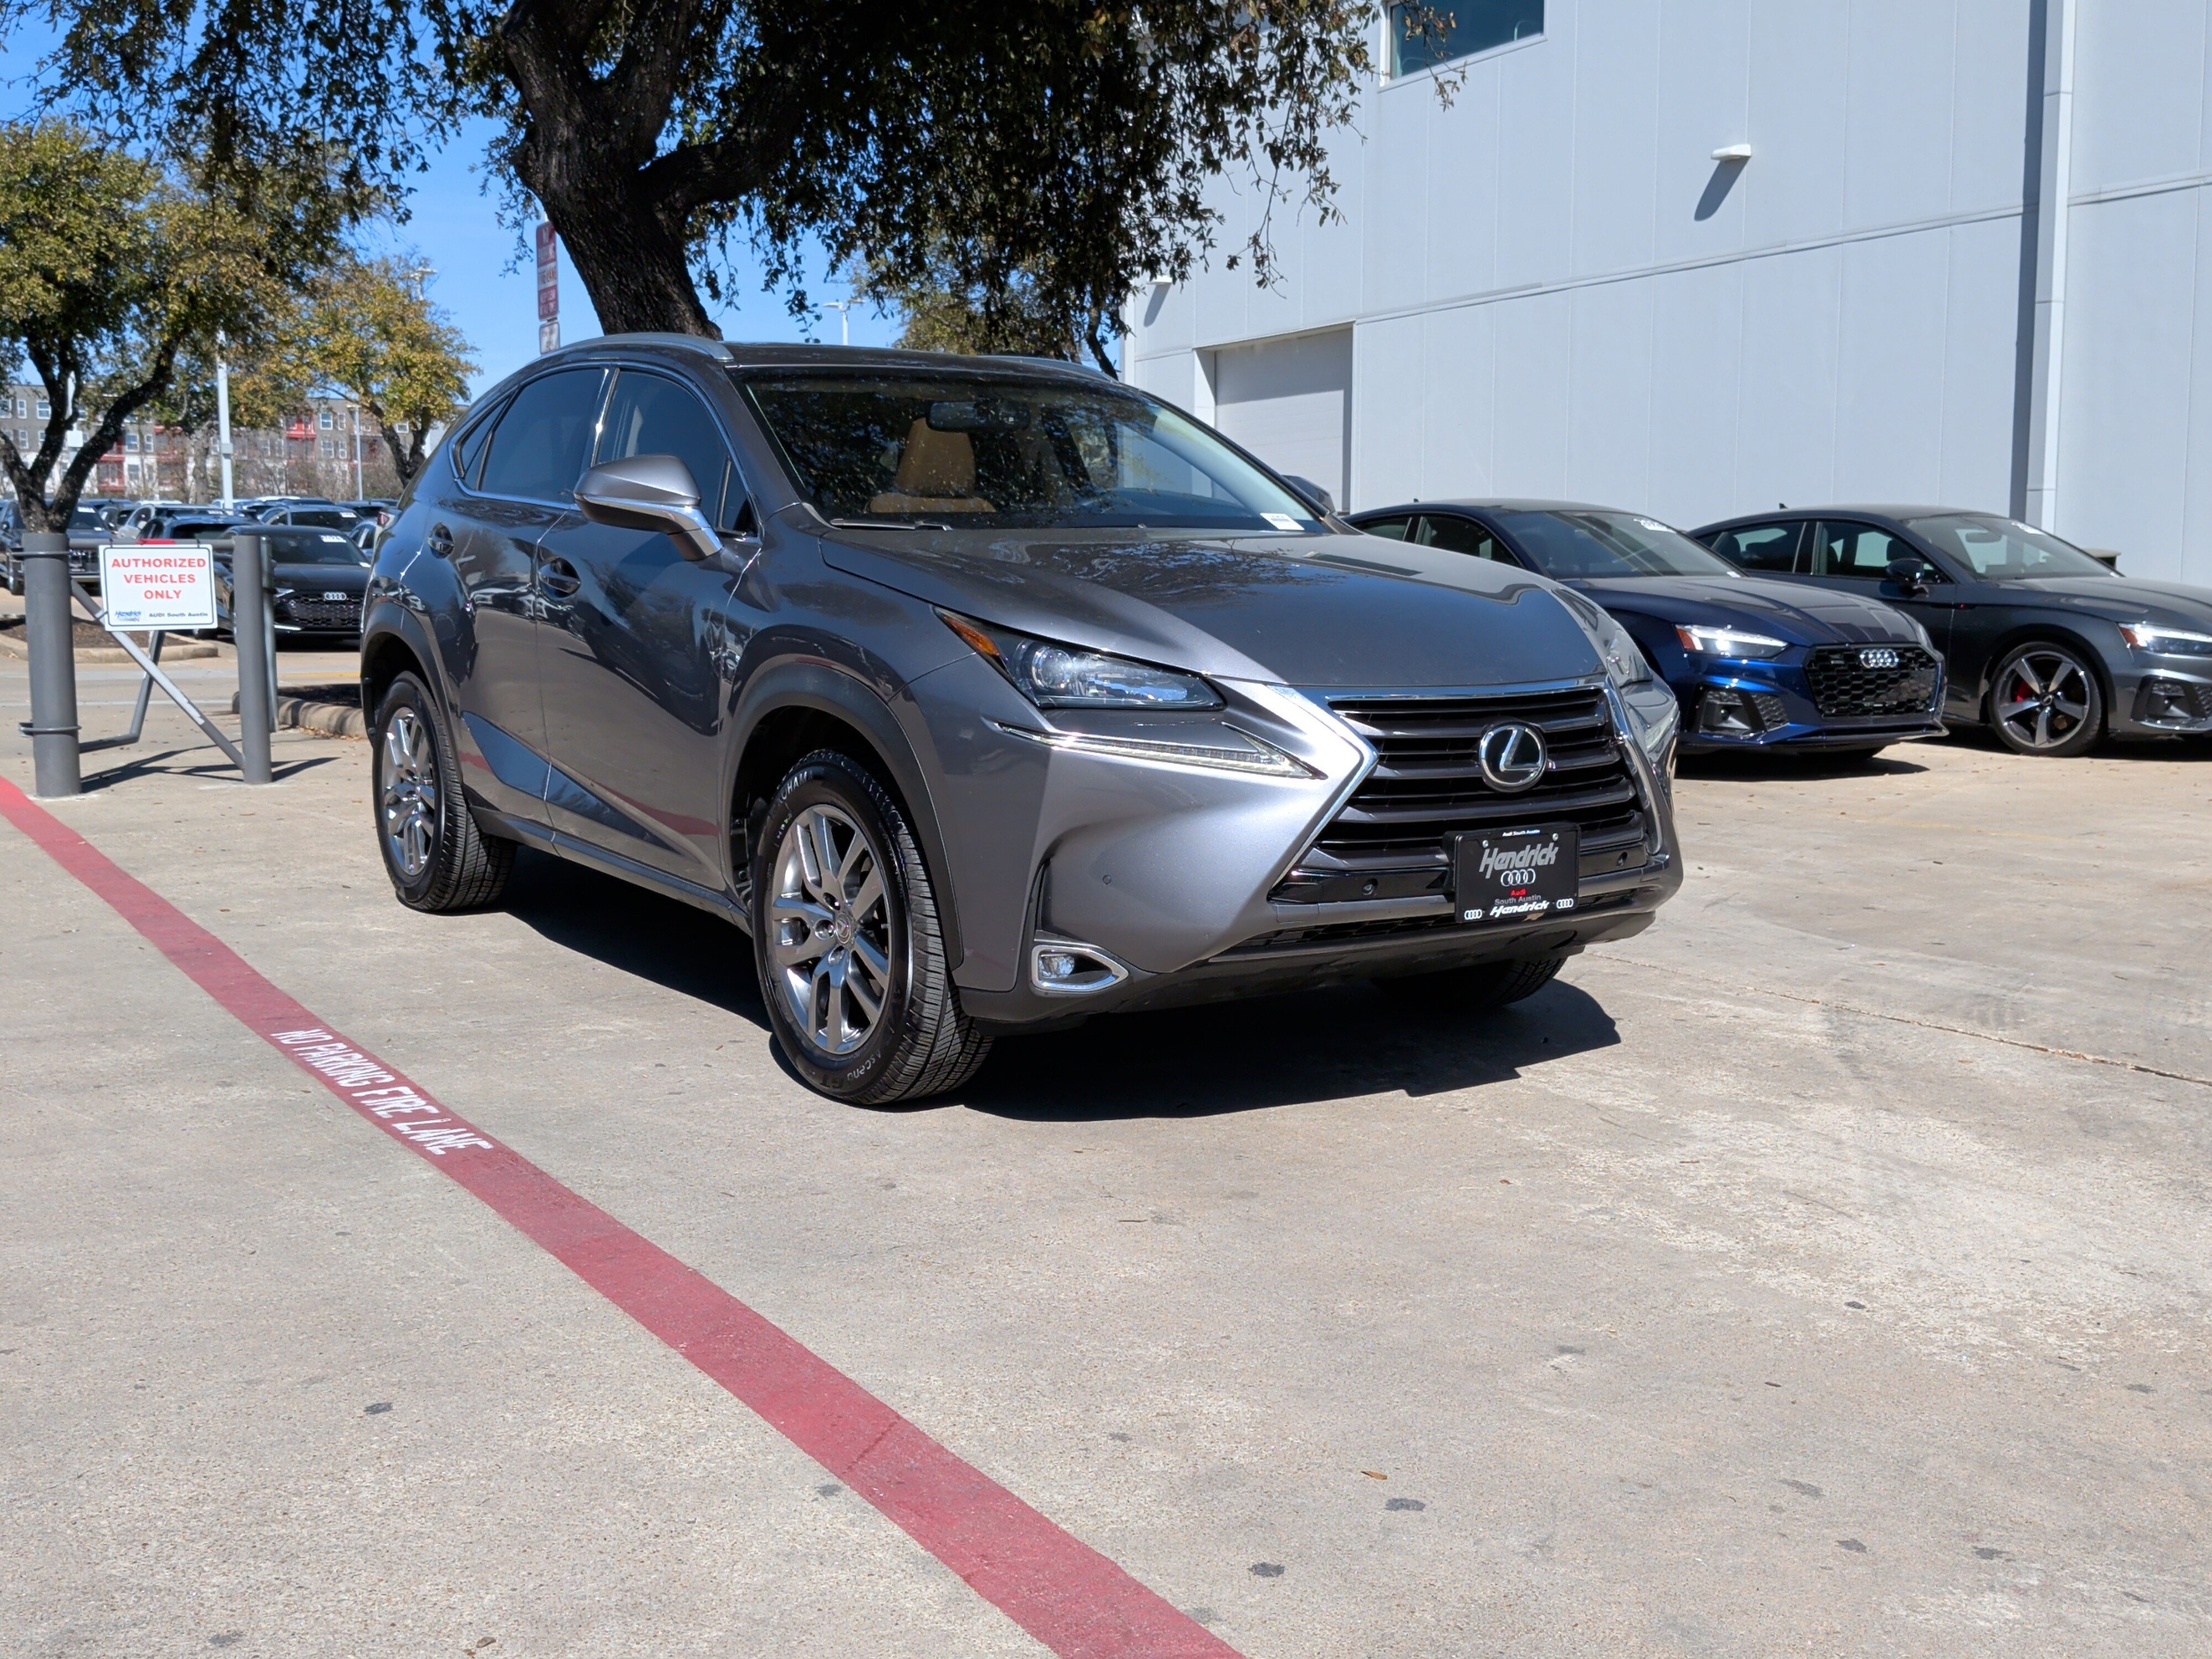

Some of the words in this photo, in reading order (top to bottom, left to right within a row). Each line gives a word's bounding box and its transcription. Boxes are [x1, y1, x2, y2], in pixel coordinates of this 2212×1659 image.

[112, 559, 206, 567] AUTHORIZED
[124, 574, 196, 583] VEHICLES
[144, 590, 182, 599] ONLY
[1479, 842, 1559, 879] Hendrick
[1495, 897, 1516, 905] South
[1519, 894, 1541, 902] Austin
[1490, 900, 1549, 917] Hendrick
[270, 1029, 333, 1044] NO
[291, 1042, 395, 1087] PARKING
[352, 1086, 440, 1118] FIRE
[392, 1118, 493, 1155] LANE
